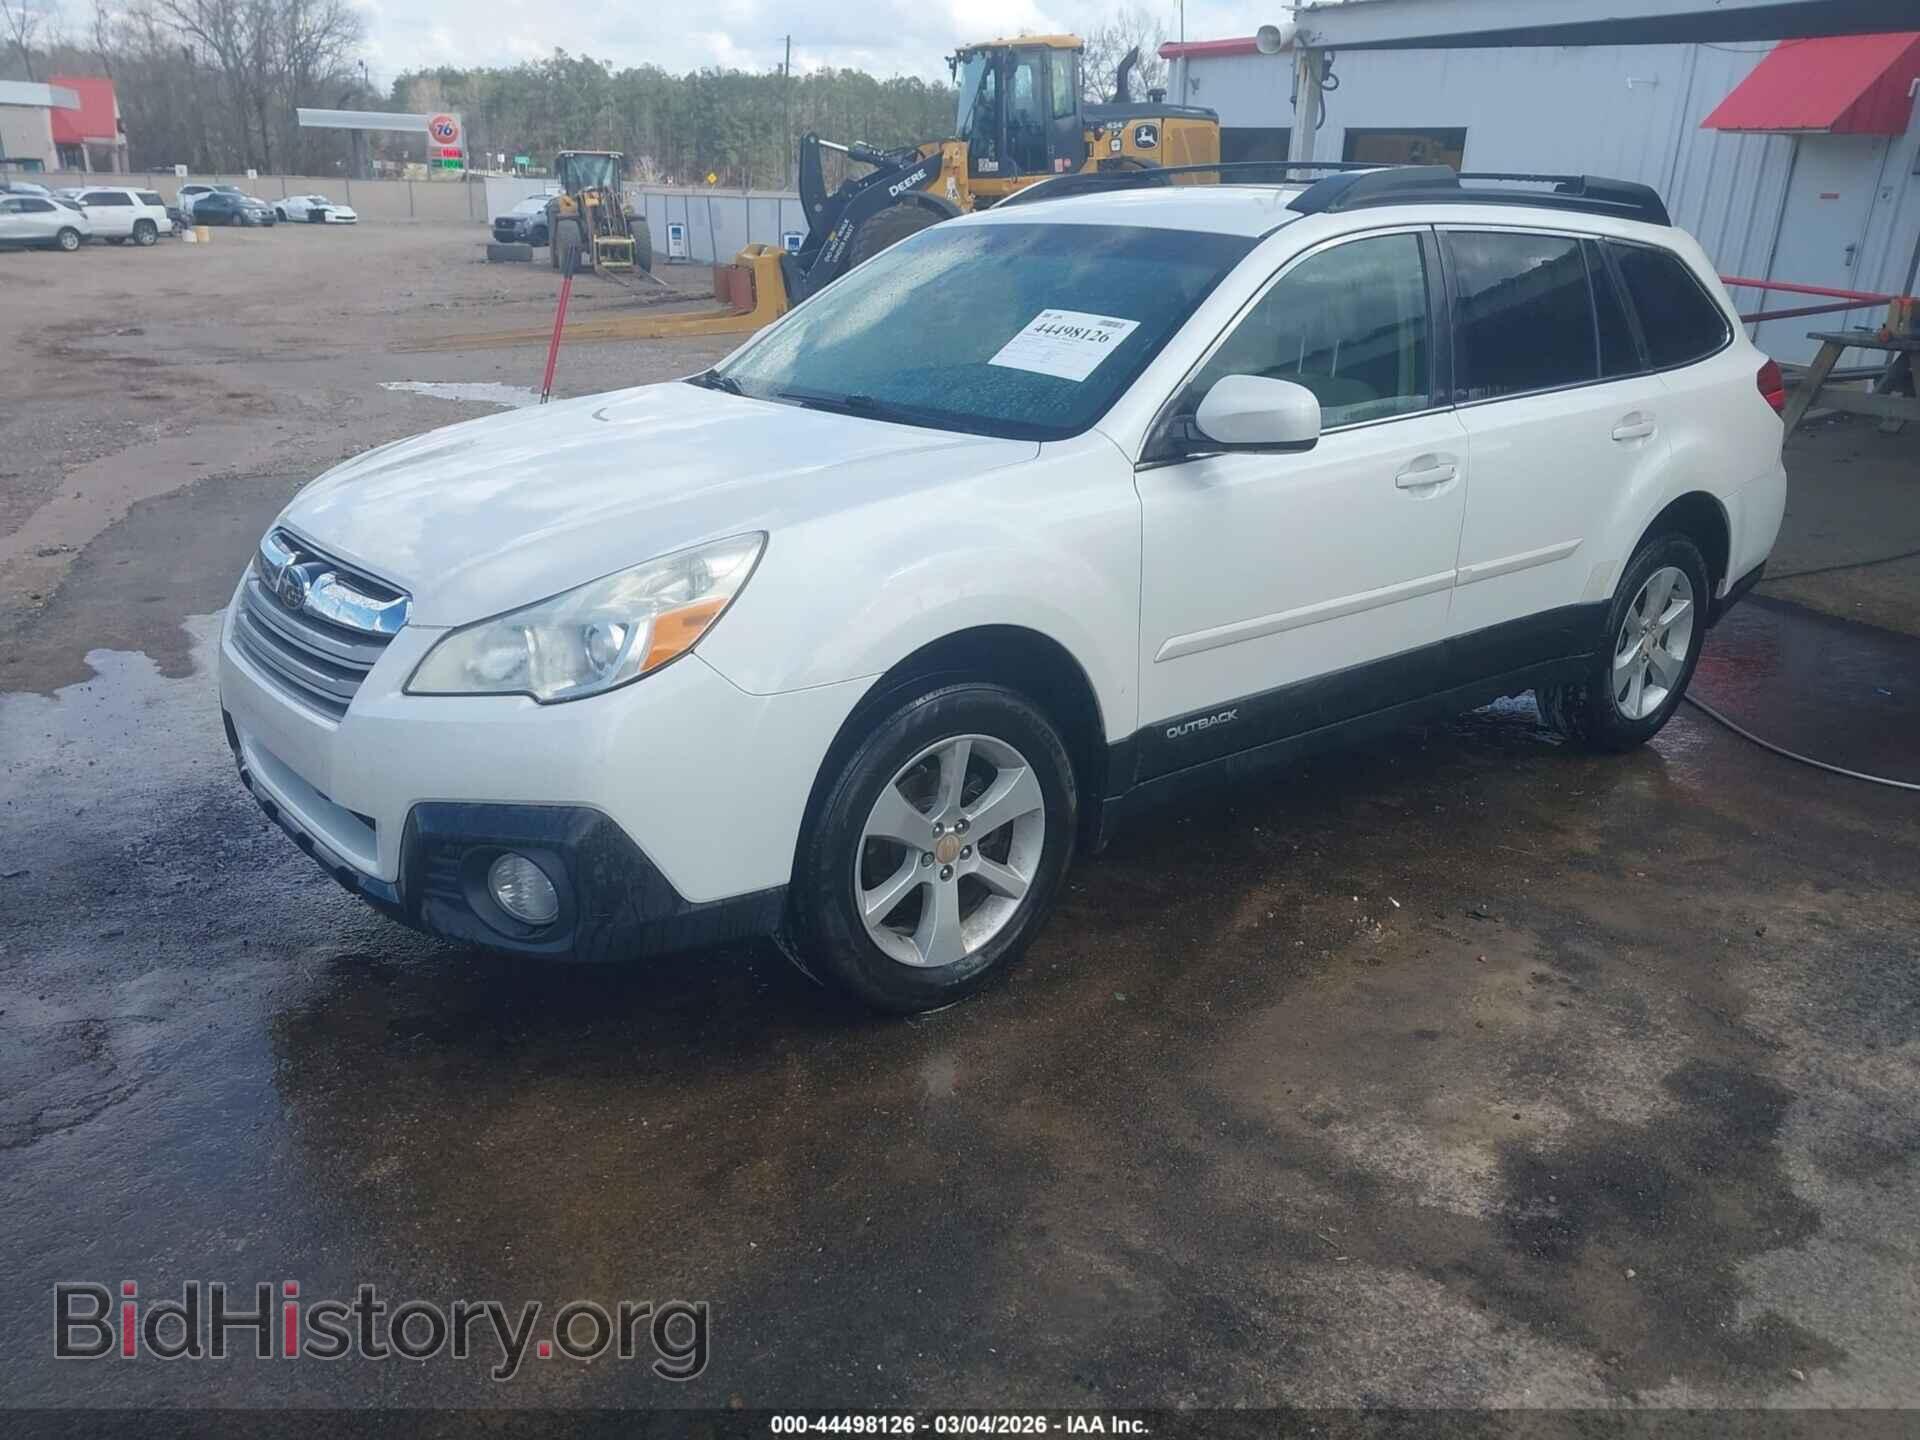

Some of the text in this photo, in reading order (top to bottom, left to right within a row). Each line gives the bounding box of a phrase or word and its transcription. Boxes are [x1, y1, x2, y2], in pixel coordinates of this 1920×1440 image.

[436, 122, 453, 136] 76
[888, 168, 927, 197] DEERE
[830, 238, 840, 251] NOT
[837, 218, 850, 237] WALK
[1033, 322, 1112, 343] 44498126
[1166, 709, 1239, 738] OUTBACK
